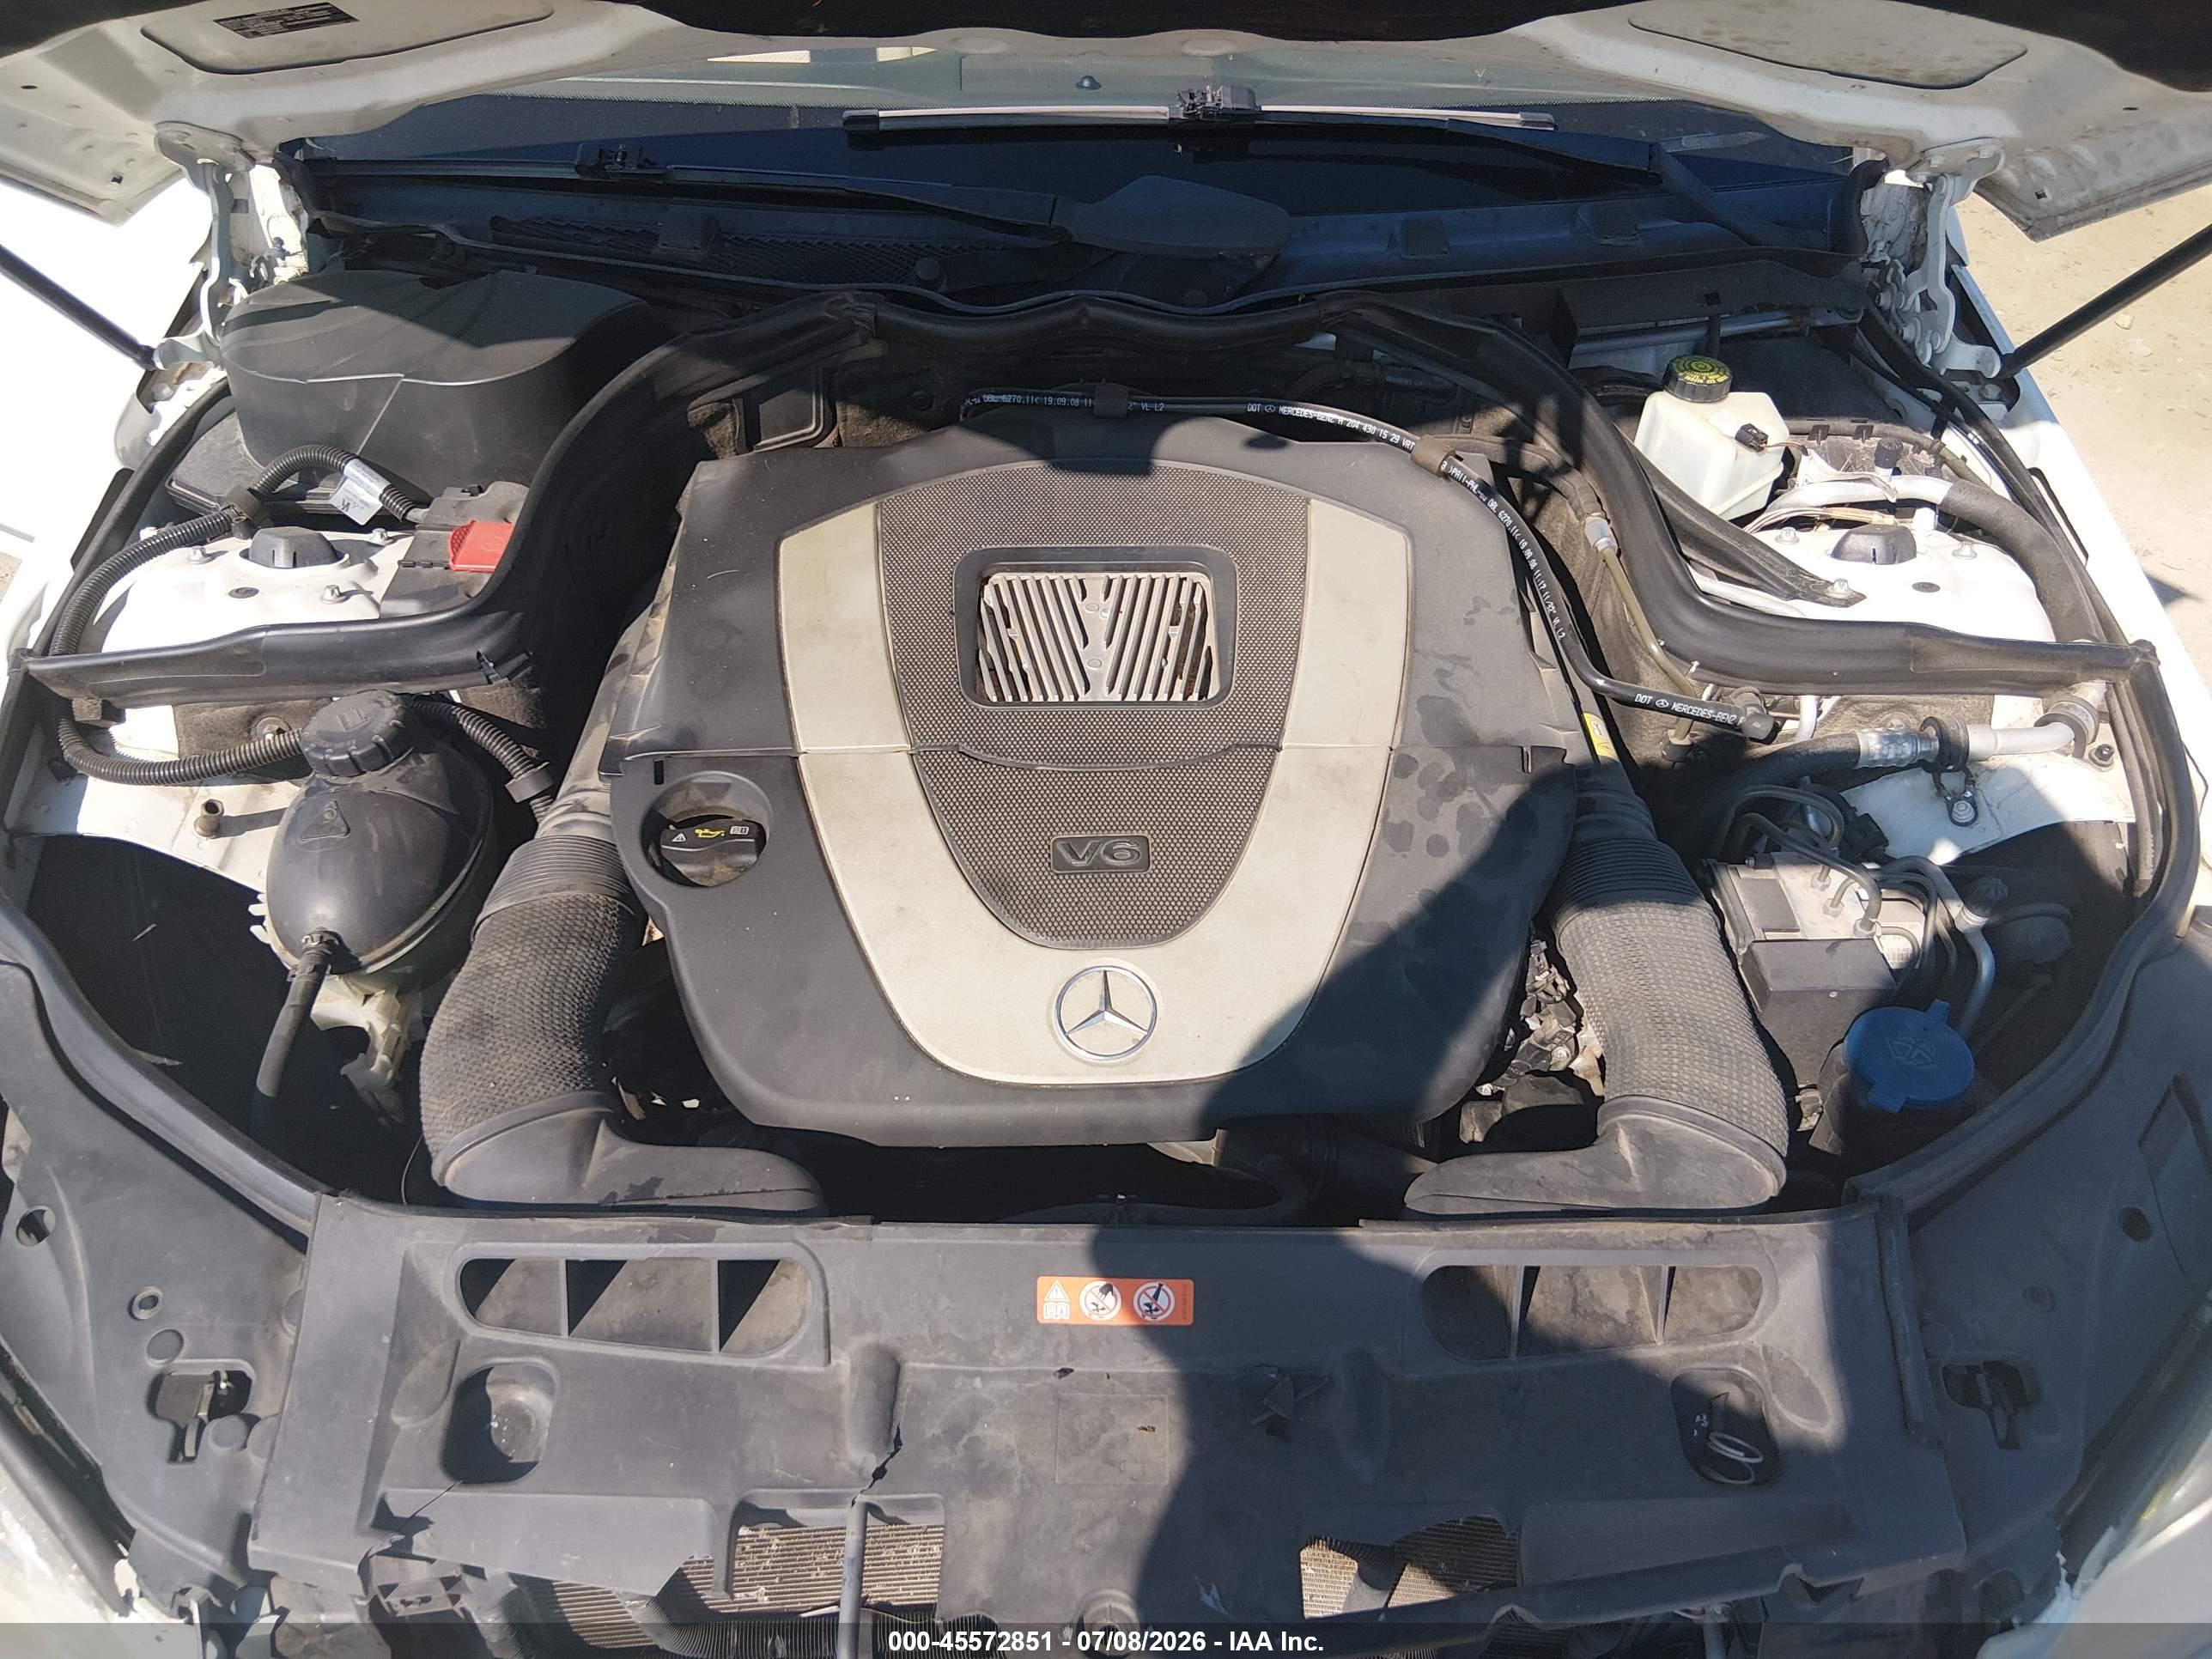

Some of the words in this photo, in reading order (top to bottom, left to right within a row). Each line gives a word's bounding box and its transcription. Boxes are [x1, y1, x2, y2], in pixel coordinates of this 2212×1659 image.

[1247, 403, 1261, 412] DOT
[1278, 405, 1335, 423] MERCEDES-BENZ
[1346, 417, 1360, 429] 204
[1362, 422, 1376, 434] 430
[1378, 428, 1389, 440] 15
[1389, 433, 1401, 444] 29
[1401, 438, 1416, 451] VRT
[1634, 693, 1653, 705] DOT
[1671, 702, 1737, 725] MERCEDES-BENZ
[1056, 839, 1141, 867] V6
